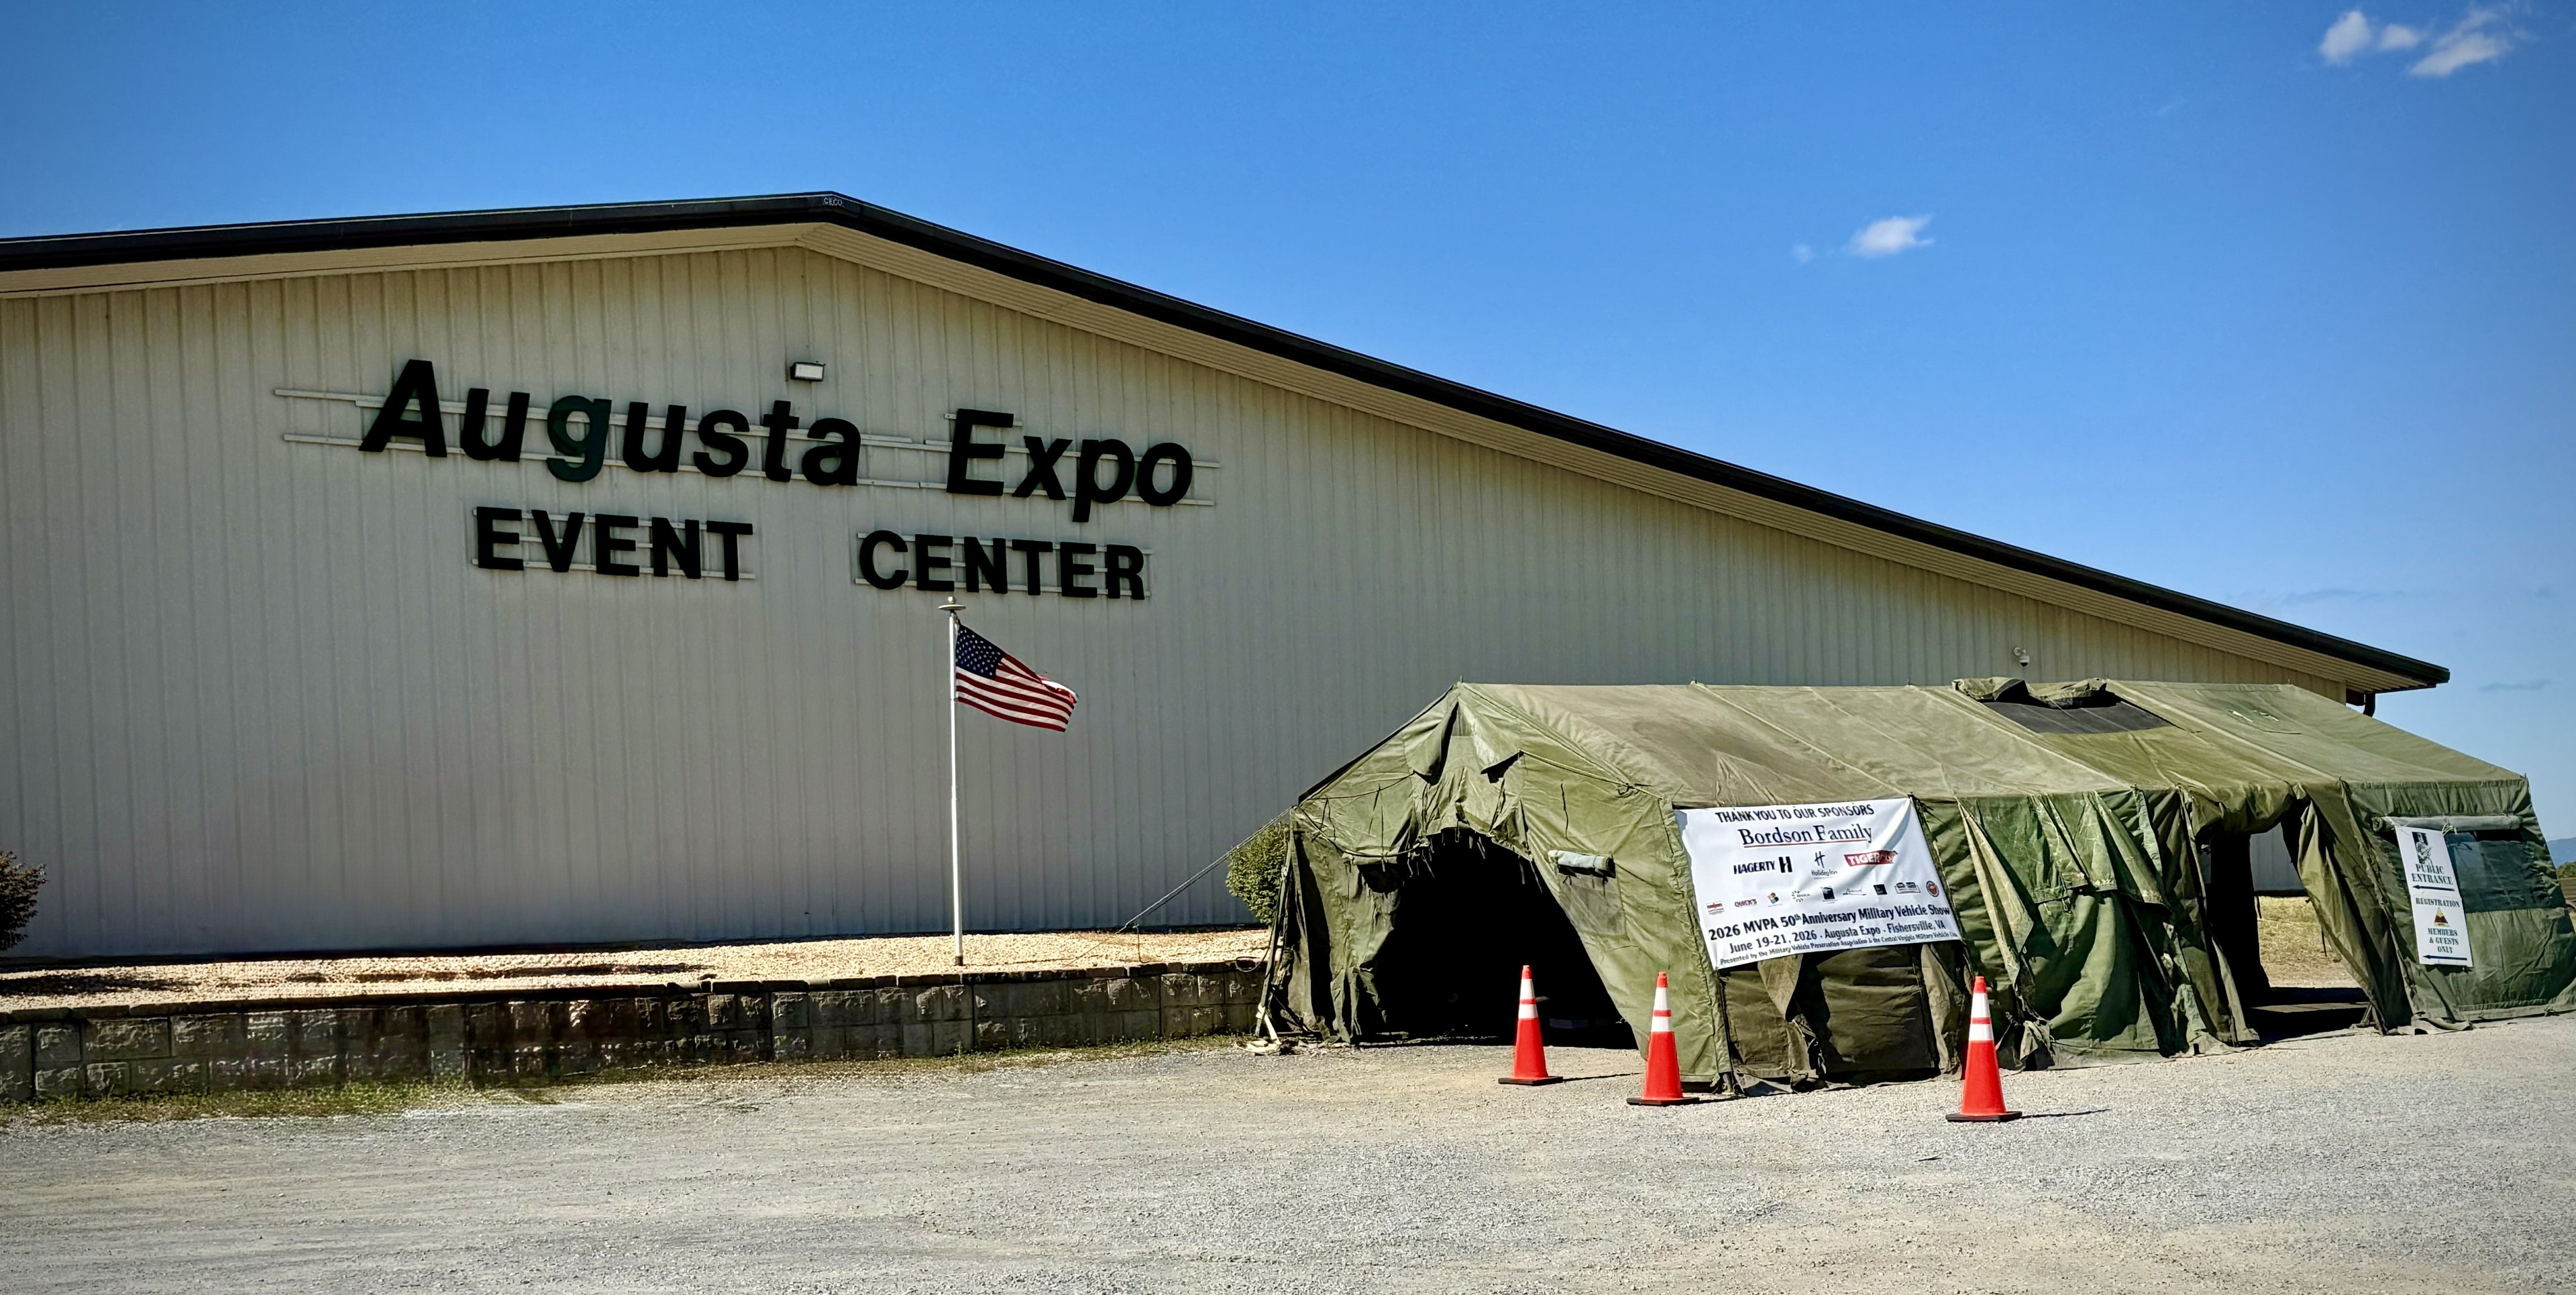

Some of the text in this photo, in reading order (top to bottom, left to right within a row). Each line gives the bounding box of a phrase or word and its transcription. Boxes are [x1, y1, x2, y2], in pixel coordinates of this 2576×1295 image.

[358, 359, 1193, 523] Augusta Expo
[475, 506, 1145, 600] EVENT CENTER
[1715, 804, 1874, 823] THANK YOU TO OUR SPONSORS
[1737, 823, 1872, 845] Bordson Family
[1733, 860, 1776, 875] HAGERTY
[2415, 863, 2445, 875] PUBLIC
[2412, 873, 2453, 885] ENTRANCE
[2416, 897, 2460, 907] REGISTRATION
[1708, 904, 1950, 941] 2026 MVPA 50th Anniversary Military Vehicle Show
[1729, 919, 1946, 954] June 19-21, 2026 Augusta Expo Fishersville, VA
[2427, 927, 2458, 937] MEMBERS
[2435, 938, 2459, 946] GUESTS
[2437, 946, 2453, 954] ONLY
[1721, 954, 1749, 965] Presented
[1768, 946, 1792, 955] Military
